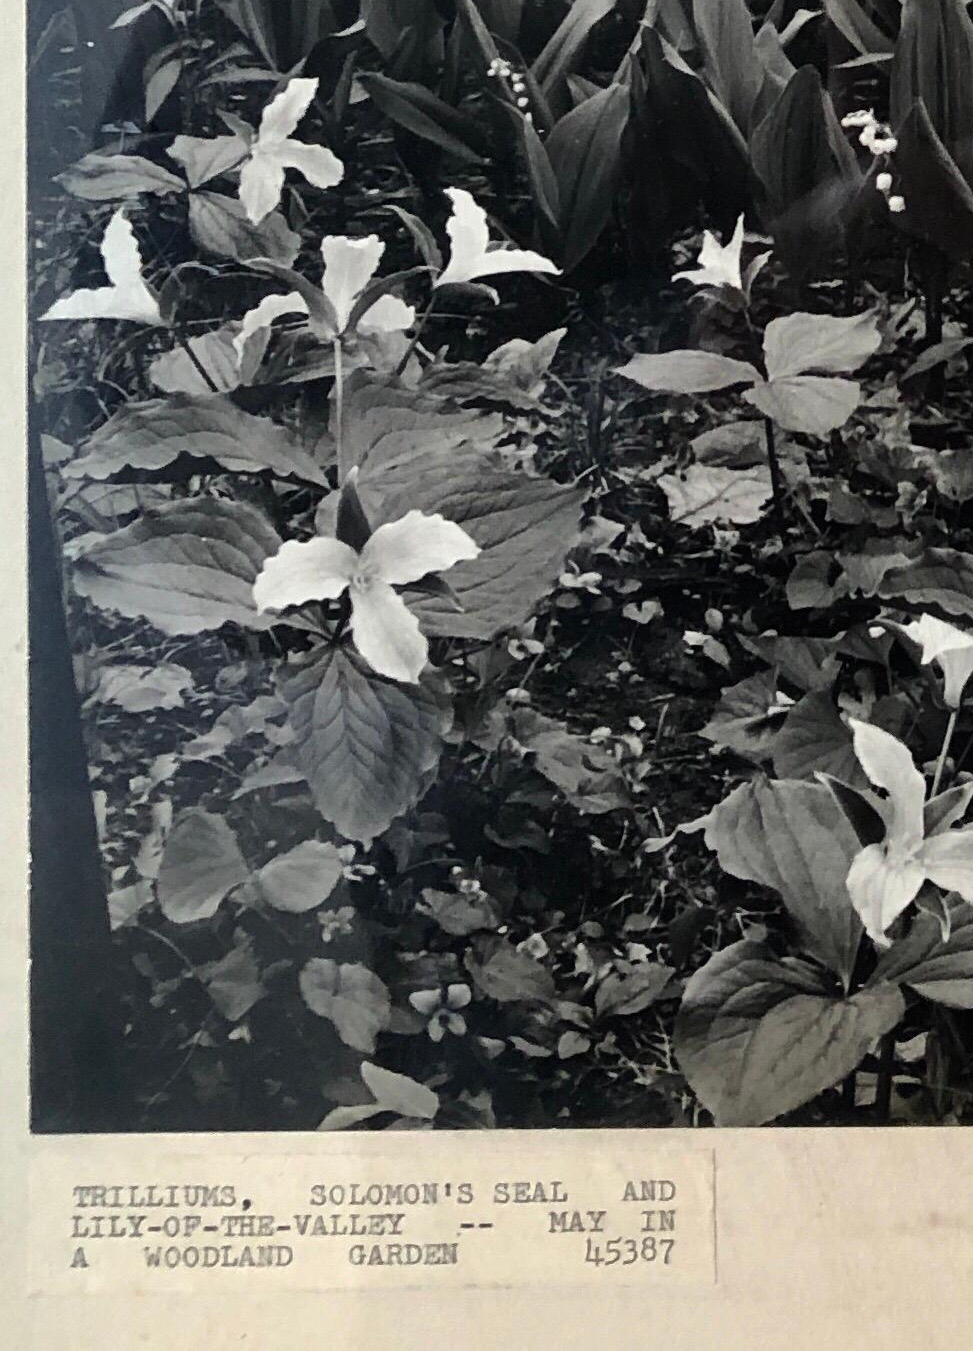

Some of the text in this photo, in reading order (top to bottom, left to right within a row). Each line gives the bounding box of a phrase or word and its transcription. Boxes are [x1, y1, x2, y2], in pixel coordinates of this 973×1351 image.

[72, 1179, 677, 1211] TRILLIUMS, SOLOMON'S SEAL AND
[70, 1213, 406, 1239] LILY-OF-THE-VALLEY
[547, 1210, 608, 1234] MAY
[640, 1209, 677, 1233] IN
[69, 1236, 676, 1269] A WOODLAND GARDEN 45387
